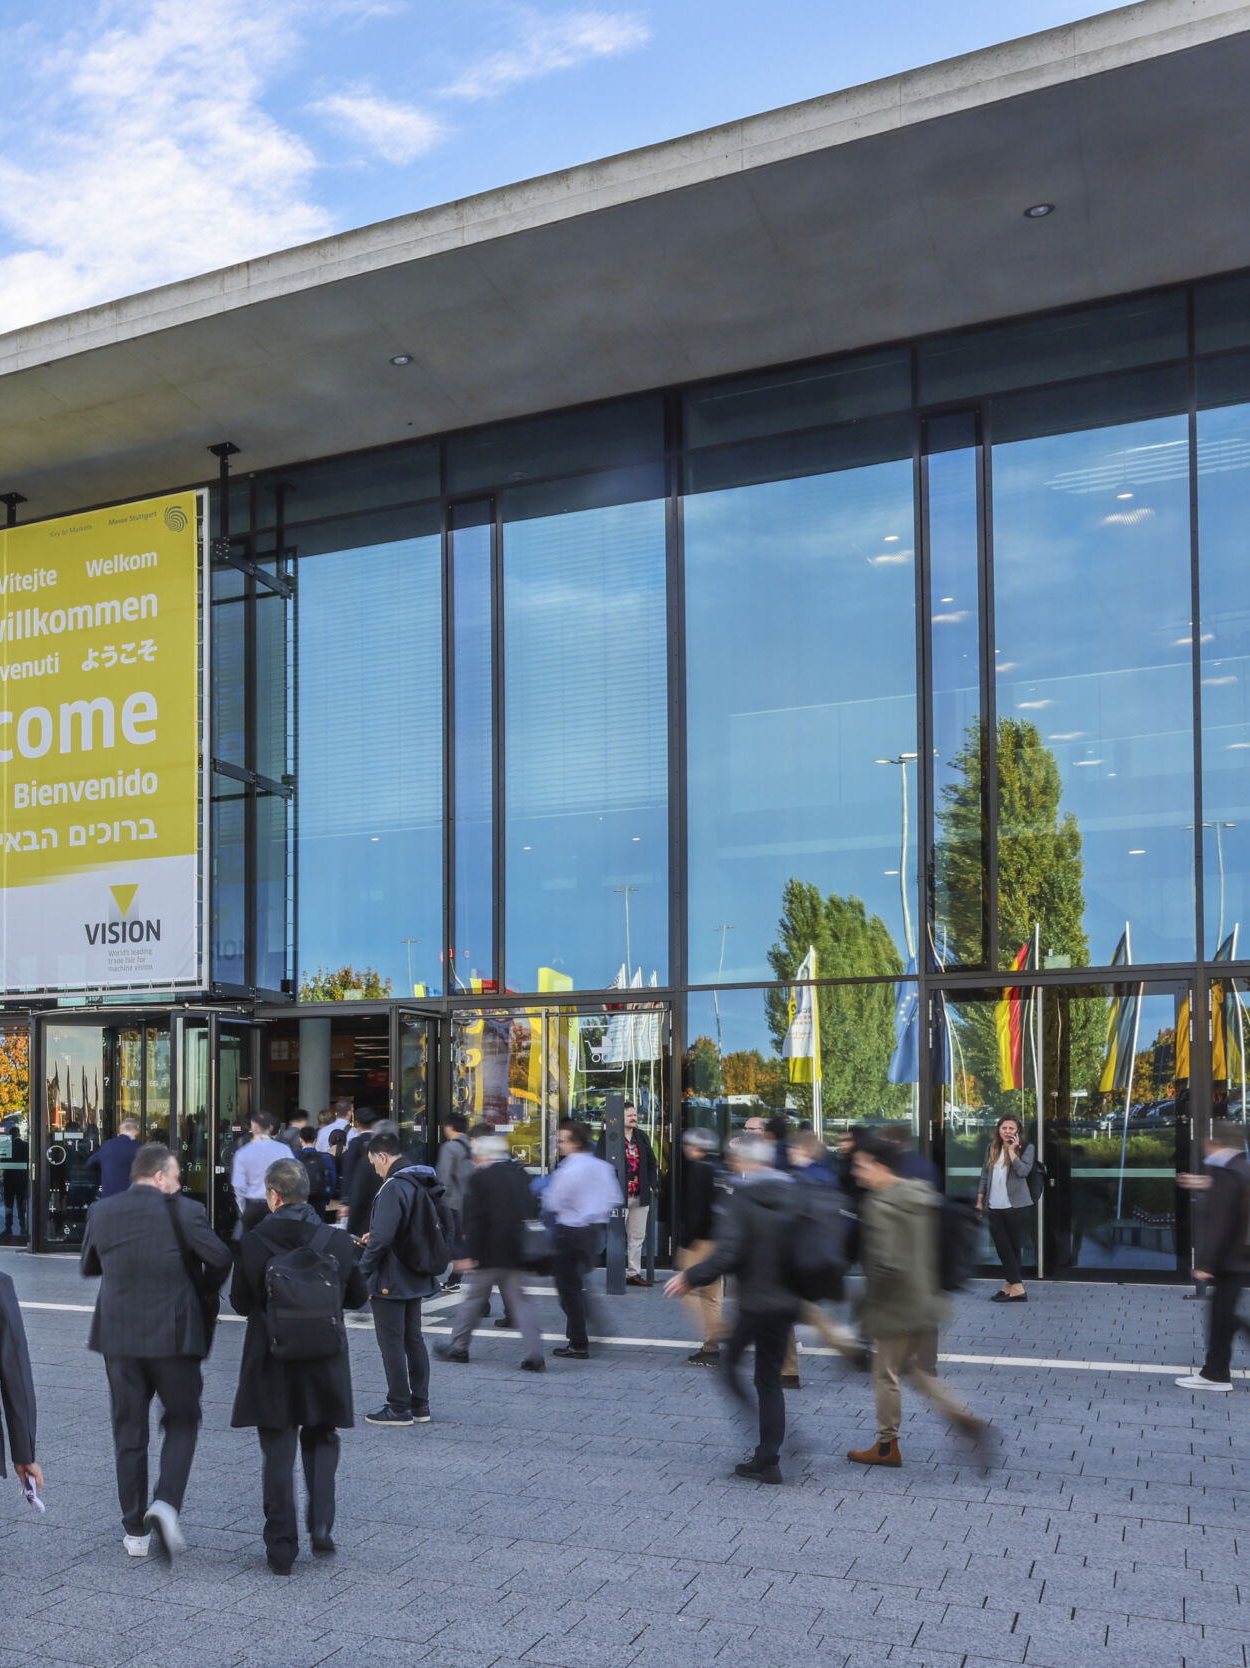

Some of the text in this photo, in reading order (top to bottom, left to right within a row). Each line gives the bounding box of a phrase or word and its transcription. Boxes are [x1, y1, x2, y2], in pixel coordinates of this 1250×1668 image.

[86, 552, 158, 578] Welkom
[81, 638, 158, 672] ようこそ
[14, 768, 158, 809] Bienvenido
[69, 818, 158, 846] ברוכים
[85, 919, 161, 946] VISION
